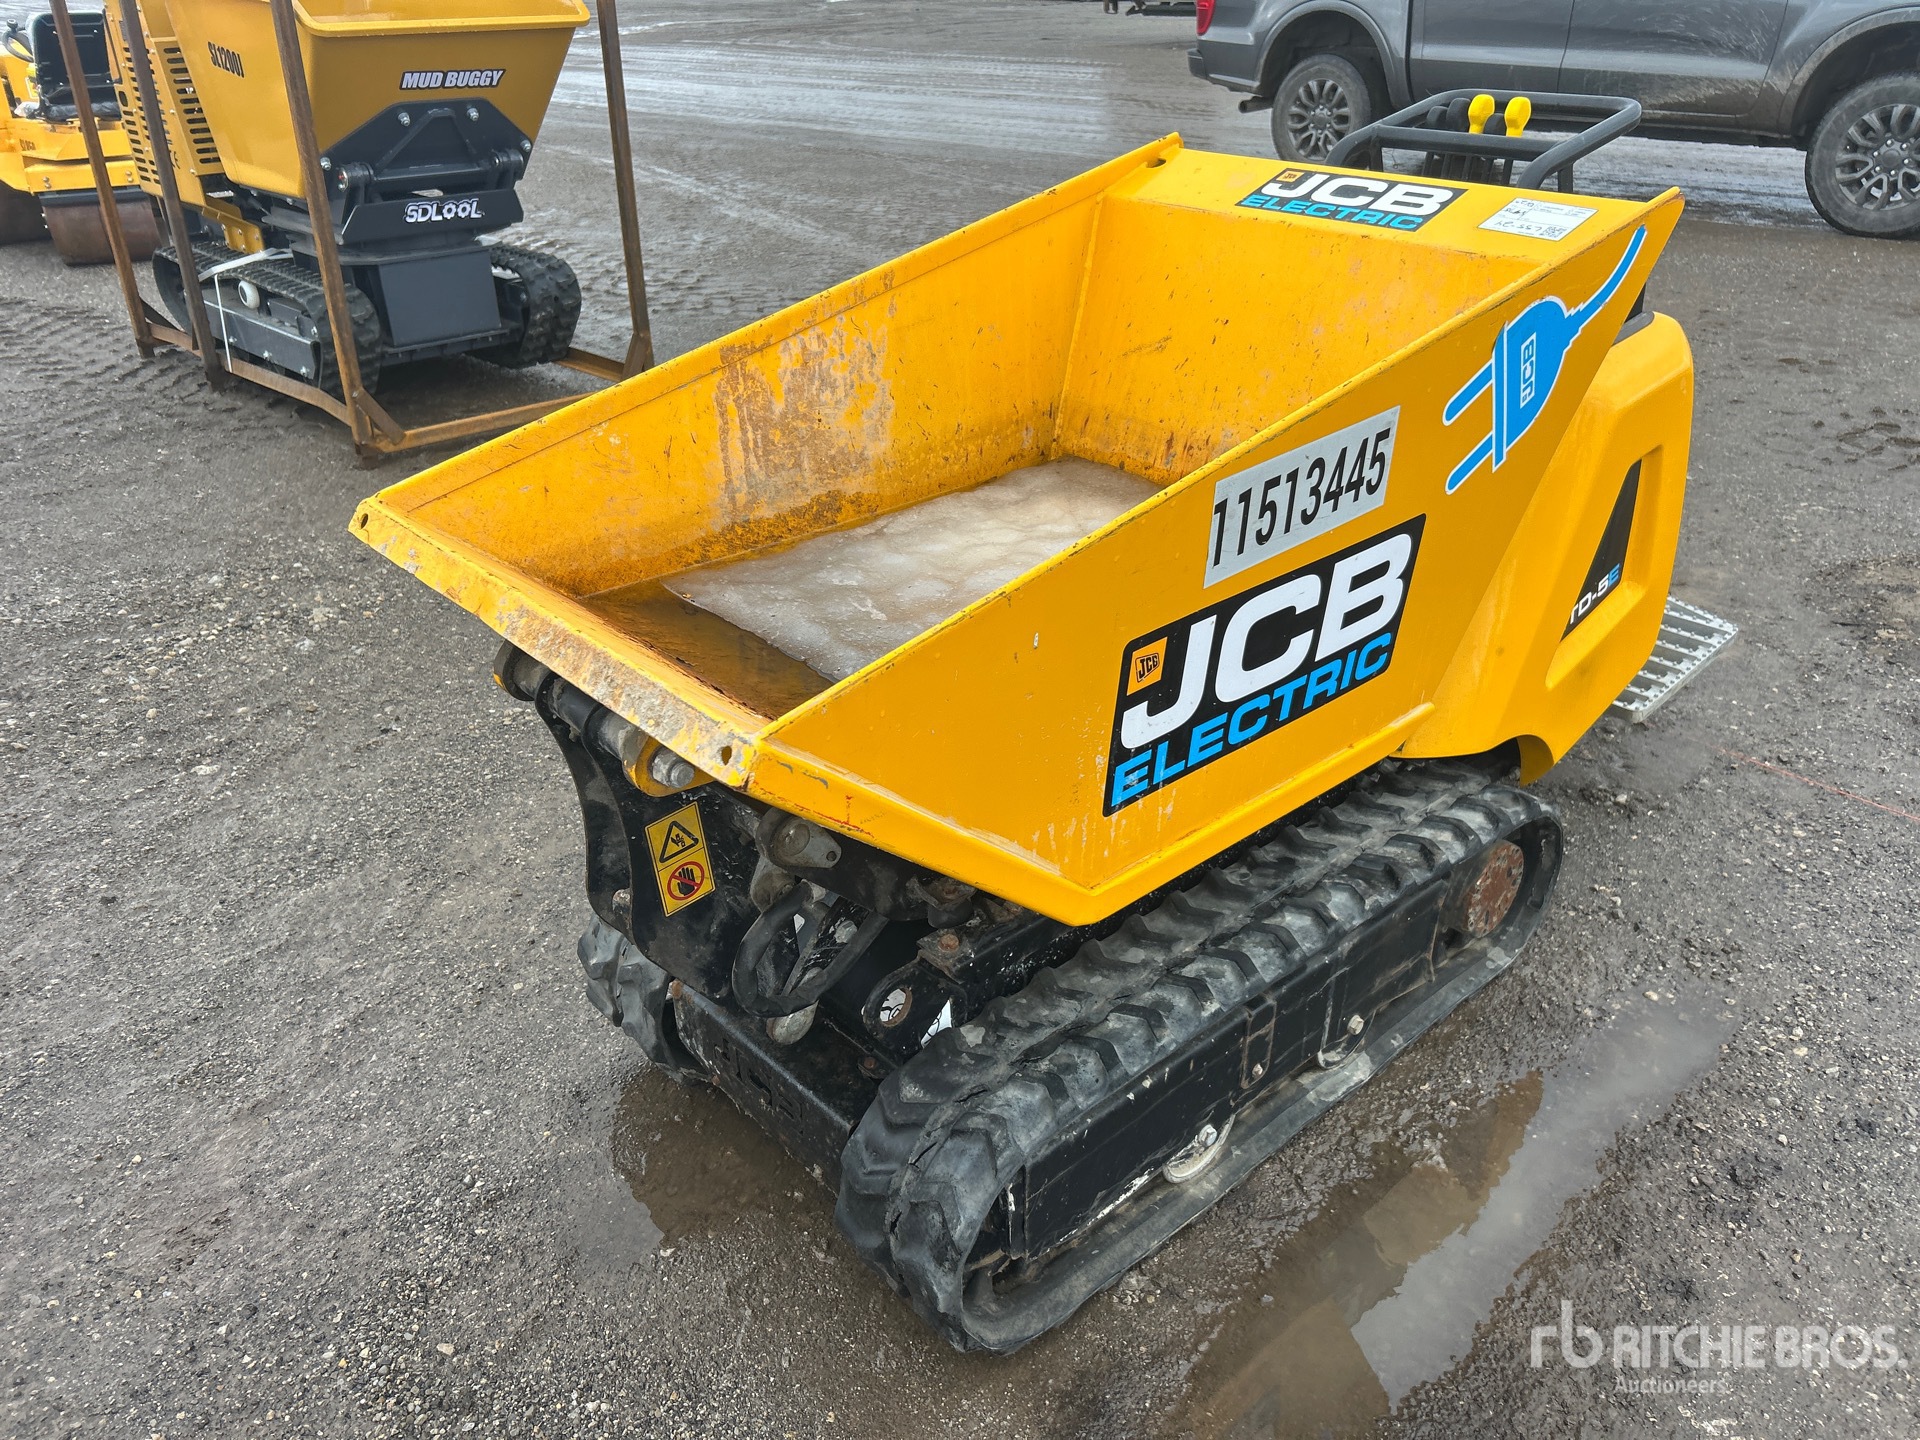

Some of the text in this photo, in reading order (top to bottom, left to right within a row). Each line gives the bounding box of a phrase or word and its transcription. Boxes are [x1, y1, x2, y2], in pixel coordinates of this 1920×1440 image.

[402, 70, 504, 89] MUD BUGGY
[1240, 193, 1424, 230] ELECTRIC
[1260, 173, 1454, 217] JCB
[1522, 338, 1535, 398] JCB
[1213, 427, 1391, 568] 11513445
[1569, 563, 1620, 625] TD-5E
[1120, 533, 1412, 749] JCB
[1138, 654, 1159, 680] JCB
[1111, 632, 1393, 807] ELECTRIC
